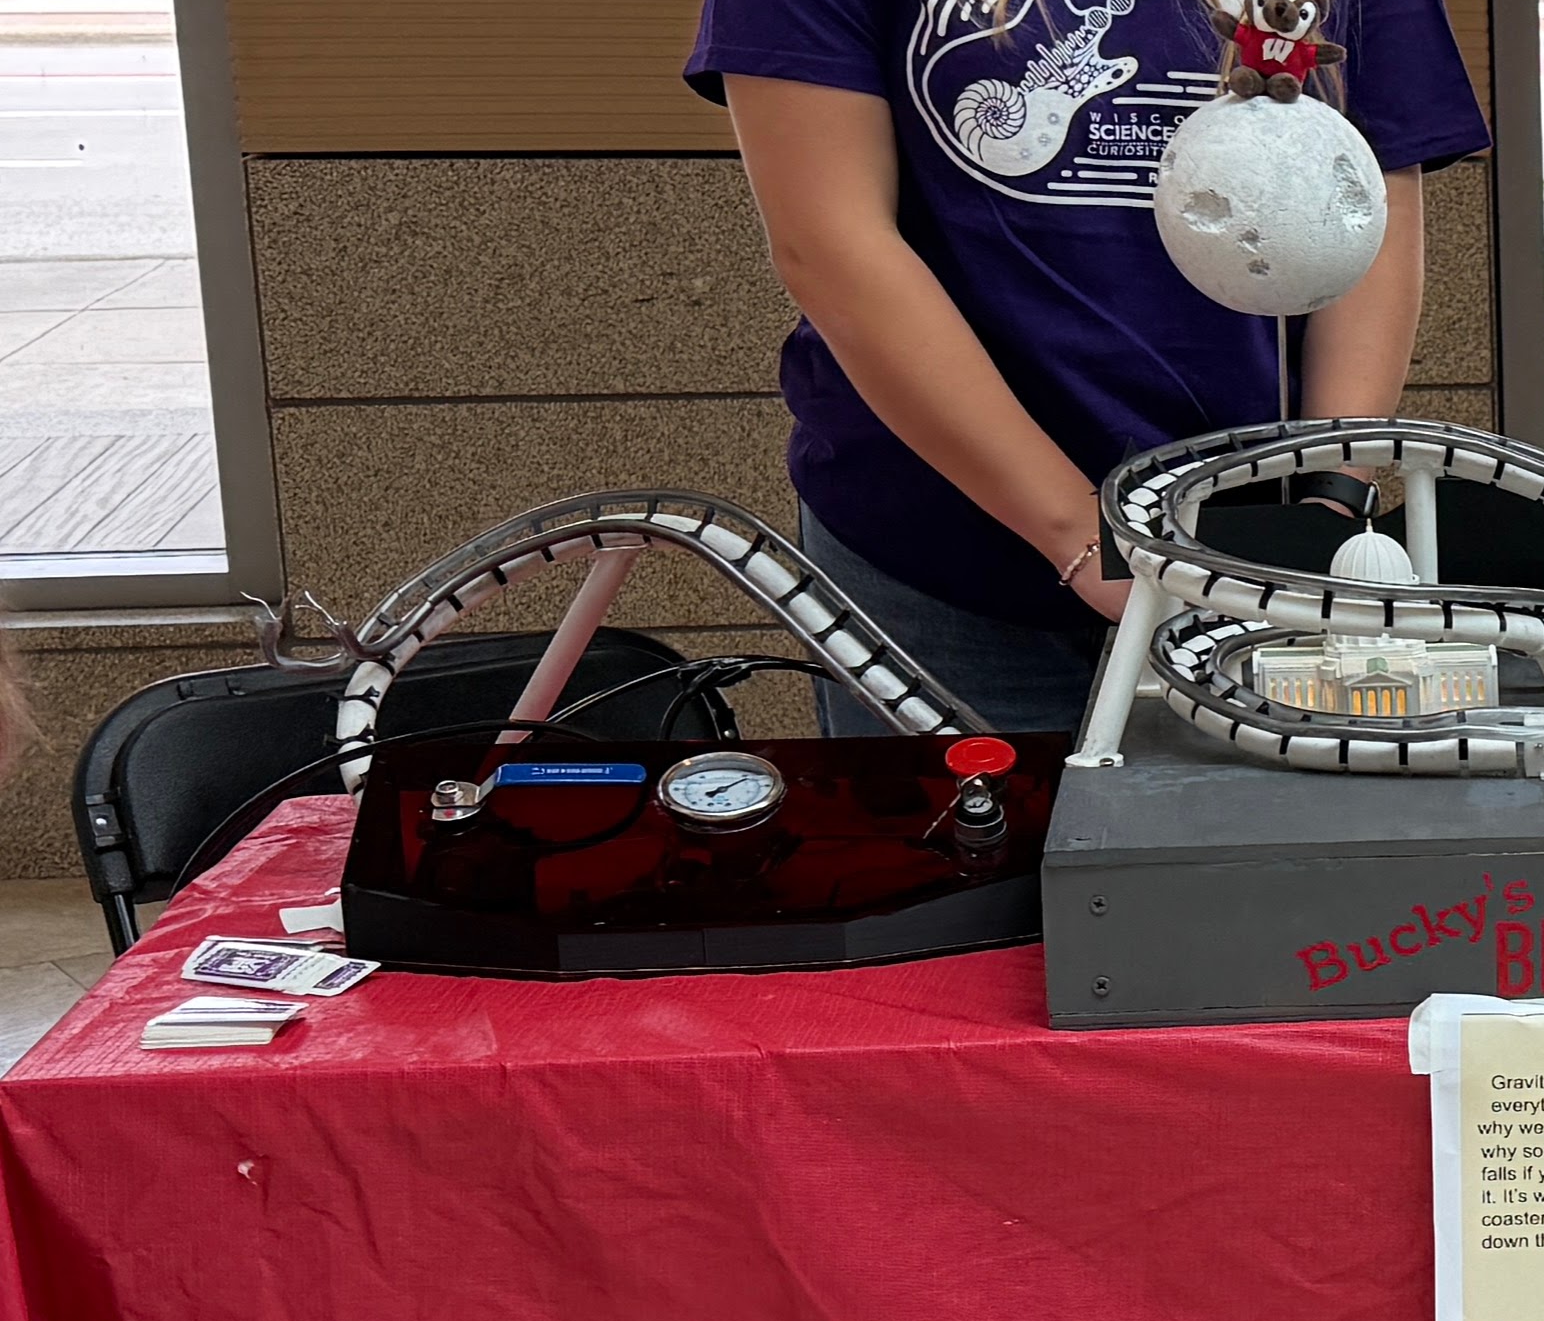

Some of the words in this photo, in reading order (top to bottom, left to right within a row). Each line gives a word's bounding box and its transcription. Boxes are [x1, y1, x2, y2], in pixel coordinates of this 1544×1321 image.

[1262, 38, 1295, 63] W
[1089, 111, 1186, 126] WISCO
[1296, 873, 1537, 992] Bucky's
[1476, 1120, 1513, 1138] why
[1518, 1122, 1544, 1134] we
[1480, 1143, 1517, 1162] why
[1481, 1165, 1517, 1181] falls
[1522, 1164, 1533, 1180] if
[1503, 1187, 1527, 1203] It's
[1481, 1234, 1528, 1249] down
